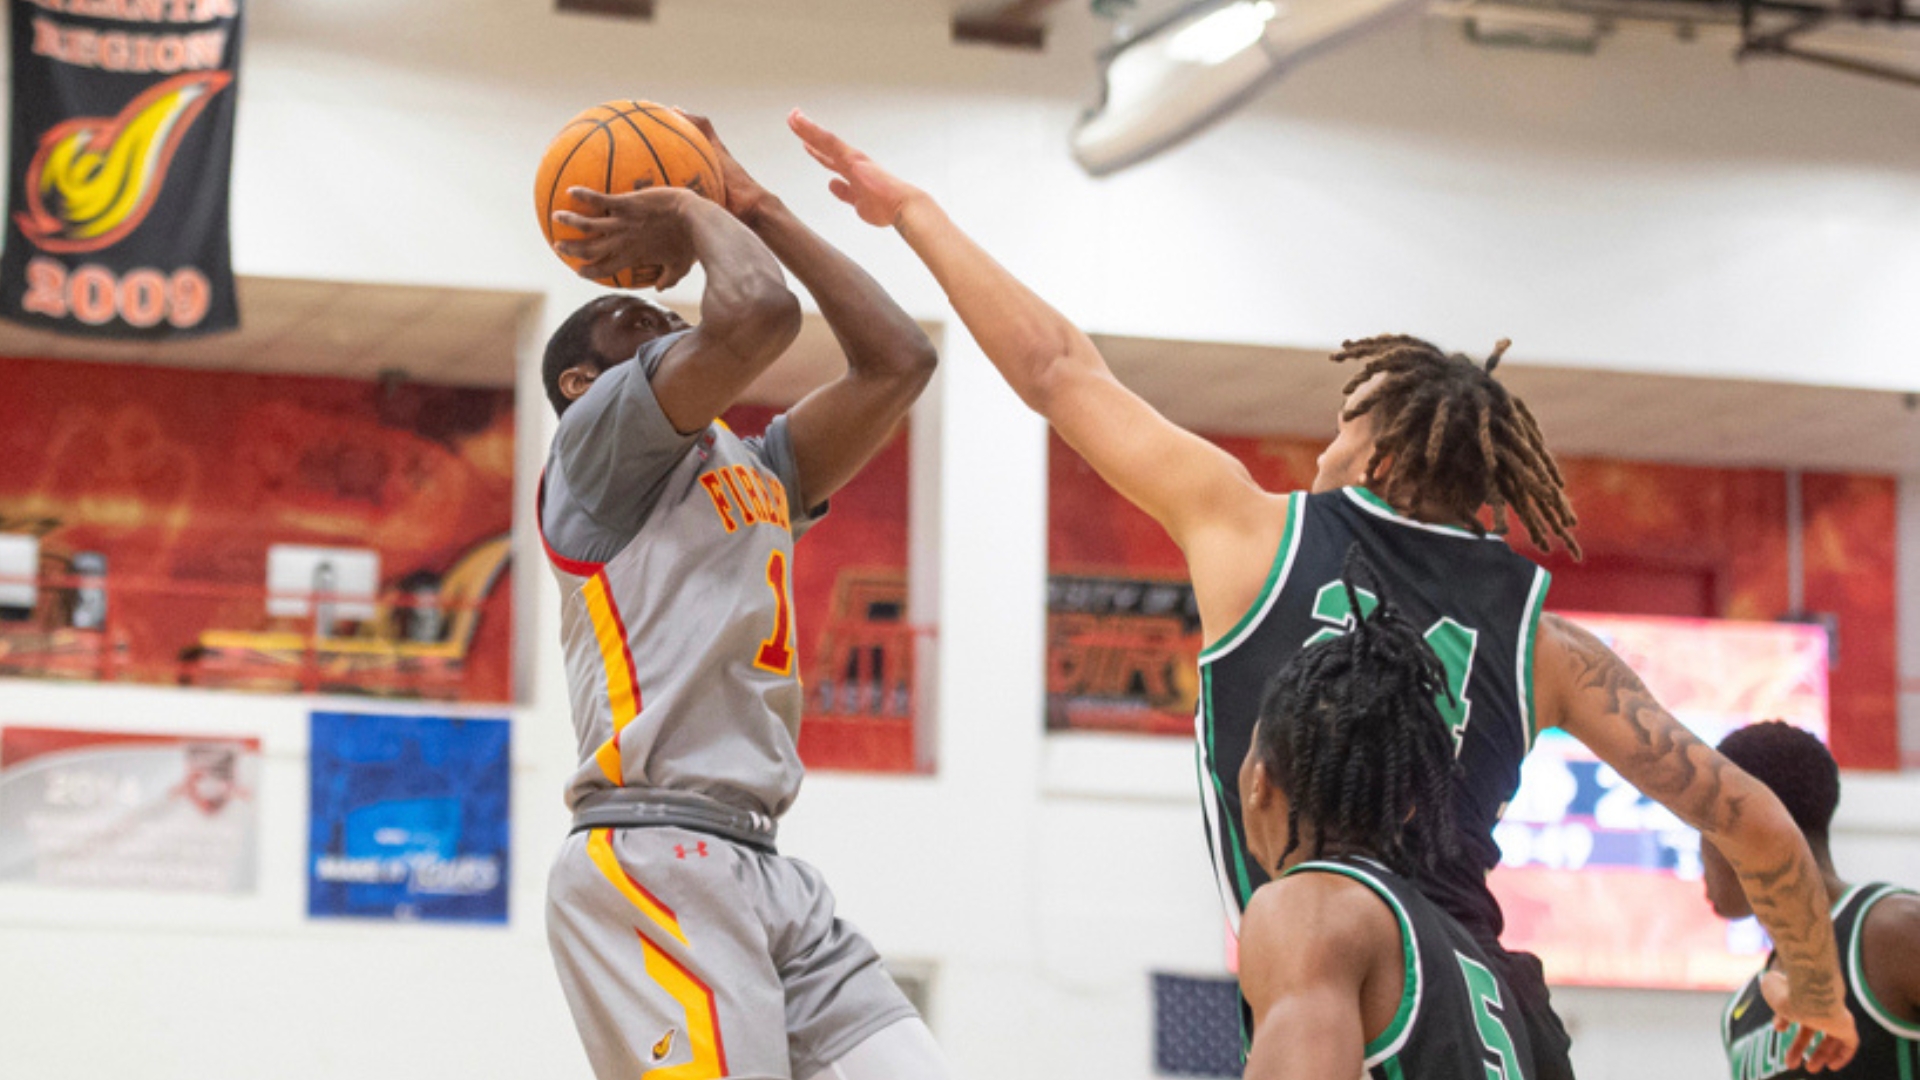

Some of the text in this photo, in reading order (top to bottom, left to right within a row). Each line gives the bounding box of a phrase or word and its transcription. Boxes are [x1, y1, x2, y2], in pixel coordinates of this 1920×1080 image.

[31, 16, 228, 73] REGION
[21, 258, 212, 328] 2009
[1452, 949, 1526, 1080] 5
